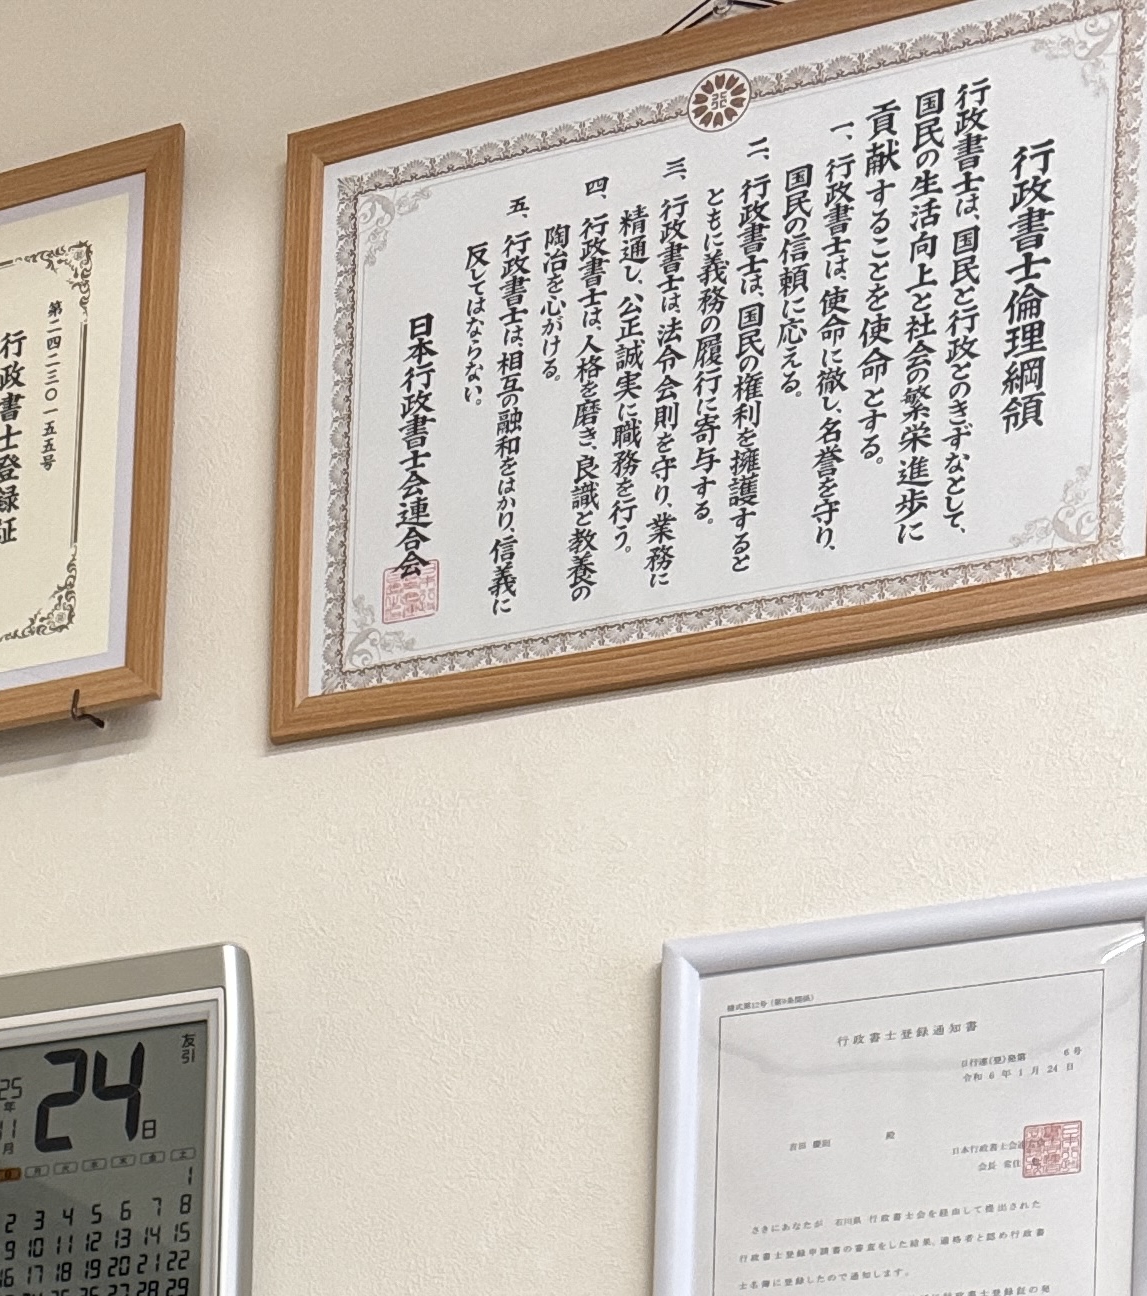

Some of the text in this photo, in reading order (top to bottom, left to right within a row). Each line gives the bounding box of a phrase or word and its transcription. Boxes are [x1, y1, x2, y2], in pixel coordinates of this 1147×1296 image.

[40, 300, 62, 471] 第二四二三〇一五五号
[465, 242, 490, 405] 反してはならない。
[540, 224, 571, 381] 陶冶を心がける。
[567, 177, 610, 601] 四、行政書士は、人格を磨き、良識と教養の
[609, 205, 649, 552] 精通し、公正誠実に職務を行う。
[644, 157, 689, 587] 三、行政書士は、法令会則を守り、業務に
[691, 188, 729, 524] ともに義務の履行に寄与する。
[728, 137, 771, 572] 二、行政書士は、国民の権利を擁護すると
[777, 164, 813, 397] 国民の信頼に応える。
[811, 122, 856, 550] 一、行政書士は、使命に徹し、名誉を守り、
[857, 100, 901, 464] 貢献することを使命とする。
[895, 88, 945, 544] 国民の生活向上と社会の繁栄進歩に
[942, 78, 991, 533] 行政書士は、国民と行政とのきずなとして、
[1000, 139, 1055, 434] 行政書士倫理綱領
[392, 313, 438, 579] 日本行政書士会連合会
[488, 196, 532, 615] 五、行政書士は、相互の融和をはかり、信義に
[0, 1119, 17, 1140] 11
[3, 1142, 14, 1155] 月
[34, 1041, 156, 1153] 24 日
[182, 1034, 195, 1064] 友引
[837, 1020, 978, 1047] 行政書士登録通知書
[0, 1250, 189, 1288] 16 17 18 19 20 21 22
[5, 1194, 192, 1233] 2 3 4 5 6 7 8
[5, 1222, 190, 1260] 9 10 11 12 13 14 15
[188, 1167, 192, 1185] 1
